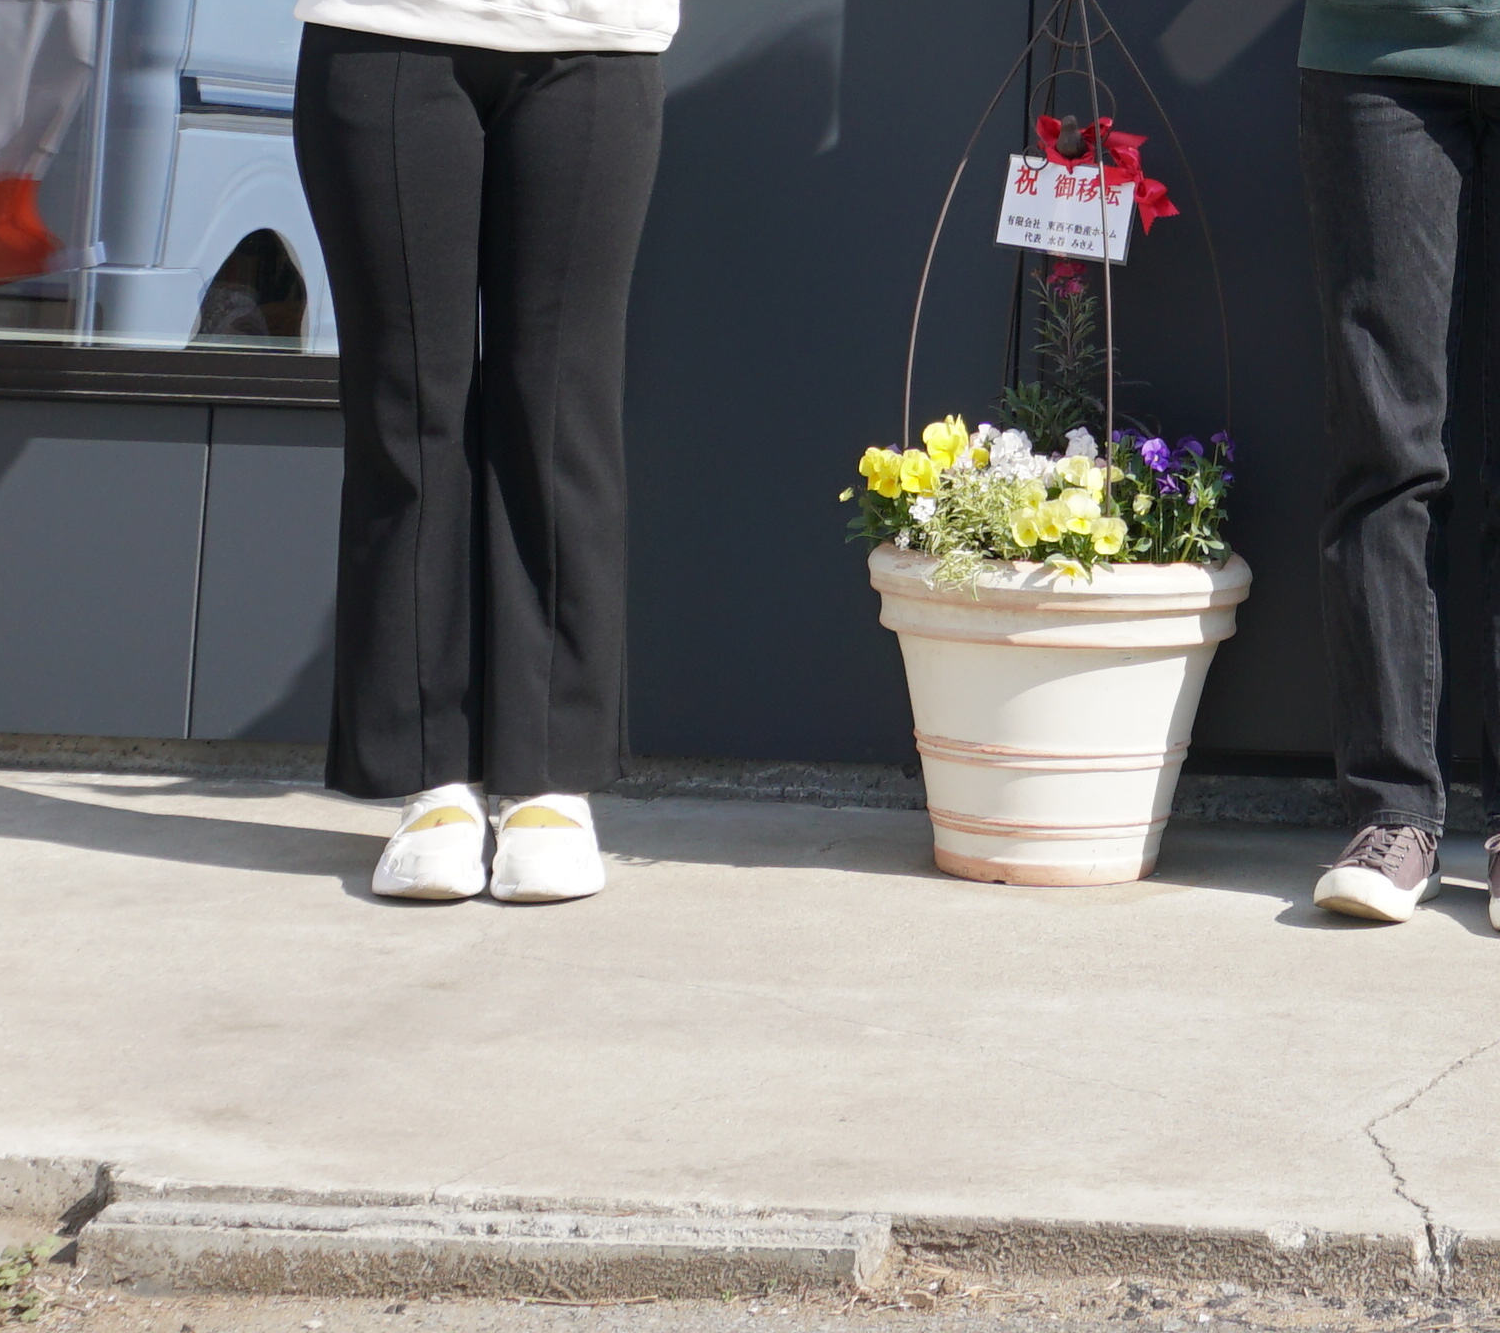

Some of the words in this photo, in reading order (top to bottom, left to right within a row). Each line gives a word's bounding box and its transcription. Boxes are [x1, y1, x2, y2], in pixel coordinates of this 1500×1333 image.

[1014, 165, 1039, 196] 祝
[1007, 215, 1041, 230] 有限会社
[1024, 231, 1041, 244] 代表
